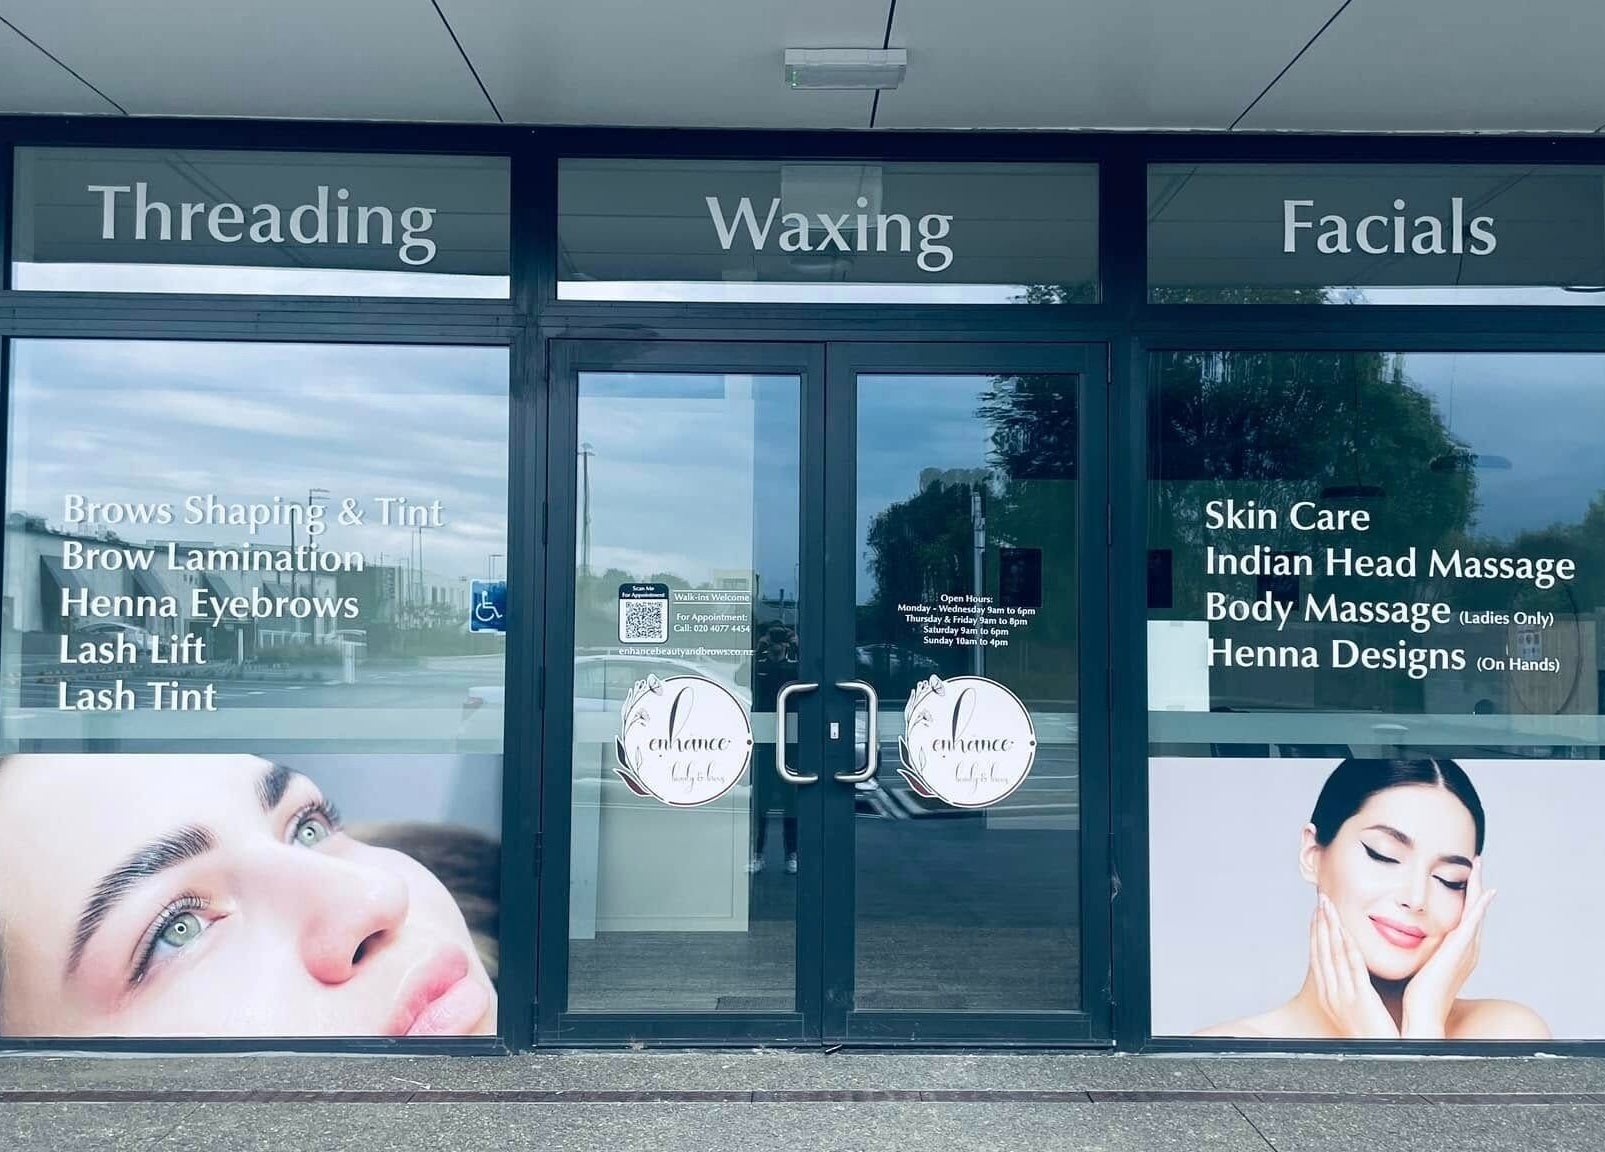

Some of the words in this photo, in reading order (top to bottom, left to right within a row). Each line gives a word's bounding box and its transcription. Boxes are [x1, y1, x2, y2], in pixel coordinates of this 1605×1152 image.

[88, 182, 437, 265] Threading
[706, 196, 954, 272] Waxing
[1283, 197, 1497, 256] Facials
[64, 494, 173, 525] Brows
[184, 494, 326, 535] Shaping
[338, 498, 365, 526] &
[374, 497, 445, 527] Tint
[1205, 499, 1278, 531] Skin
[1289, 501, 1371, 532] Care
[62, 541, 155, 571] Brow
[168, 541, 365, 572] Lamination
[1206, 545, 1313, 577] Indian
[1326, 547, 1417, 578] Head
[1428, 549, 1576, 589] Massage
[61, 588, 178, 618] Henna
[190, 588, 360, 627] Eyebrows
[674, 593, 710, 602] Walk-ins
[711, 593, 750, 602] Welcome
[898, 604, 931, 613] Monday
[938, 604, 986, 614] Wednesday
[987, 606, 1005, 614] 9am
[1006, 606, 1015, 614] to
[1017, 607, 1036, 616] 6pm
[940, 594, 964, 604] Open
[965, 594, 993, 603] Hours:
[1206, 591, 1293, 631] Body
[1304, 593, 1451, 633] Massage
[1459, 611, 1510, 627] (Ladies
[1513, 611, 1555, 629] Only)
[673, 624, 692, 633] Call:
[693, 625, 708, 633] 020
[711, 625, 730, 633] 4077
[731, 625, 750, 633] 4454
[676, 613, 691, 621] For
[692, 613, 748, 623] Appointment:
[905, 614, 943, 624] Thursday
[953, 615, 978, 626] Friday
[979, 617, 997, 625] 9am
[998, 617, 1007, 625] to
[1009, 618, 1028, 627] 8pm
[923, 626, 959, 636] Saturday
[960, 627, 978, 635] 9am
[990, 628, 1009, 637] 6pm
[60, 633, 138, 664] Lash
[151, 632, 207, 665] Lift
[923, 636, 954, 646] Sunday
[956, 637, 978, 645] 10am
[980, 638, 988, 646] to
[990, 638, 1009, 648] 4pm
[1206, 637, 1319, 669] Henna
[1331, 639, 1467, 679] Designs
[1476, 656, 1505, 672] (On
[1509, 657, 1560, 673] Hands)
[58, 680, 136, 711] Lash
[147, 681, 217, 712] Tint
[648, 686, 731, 752] enhance
[932, 687, 1014, 753] enhance
